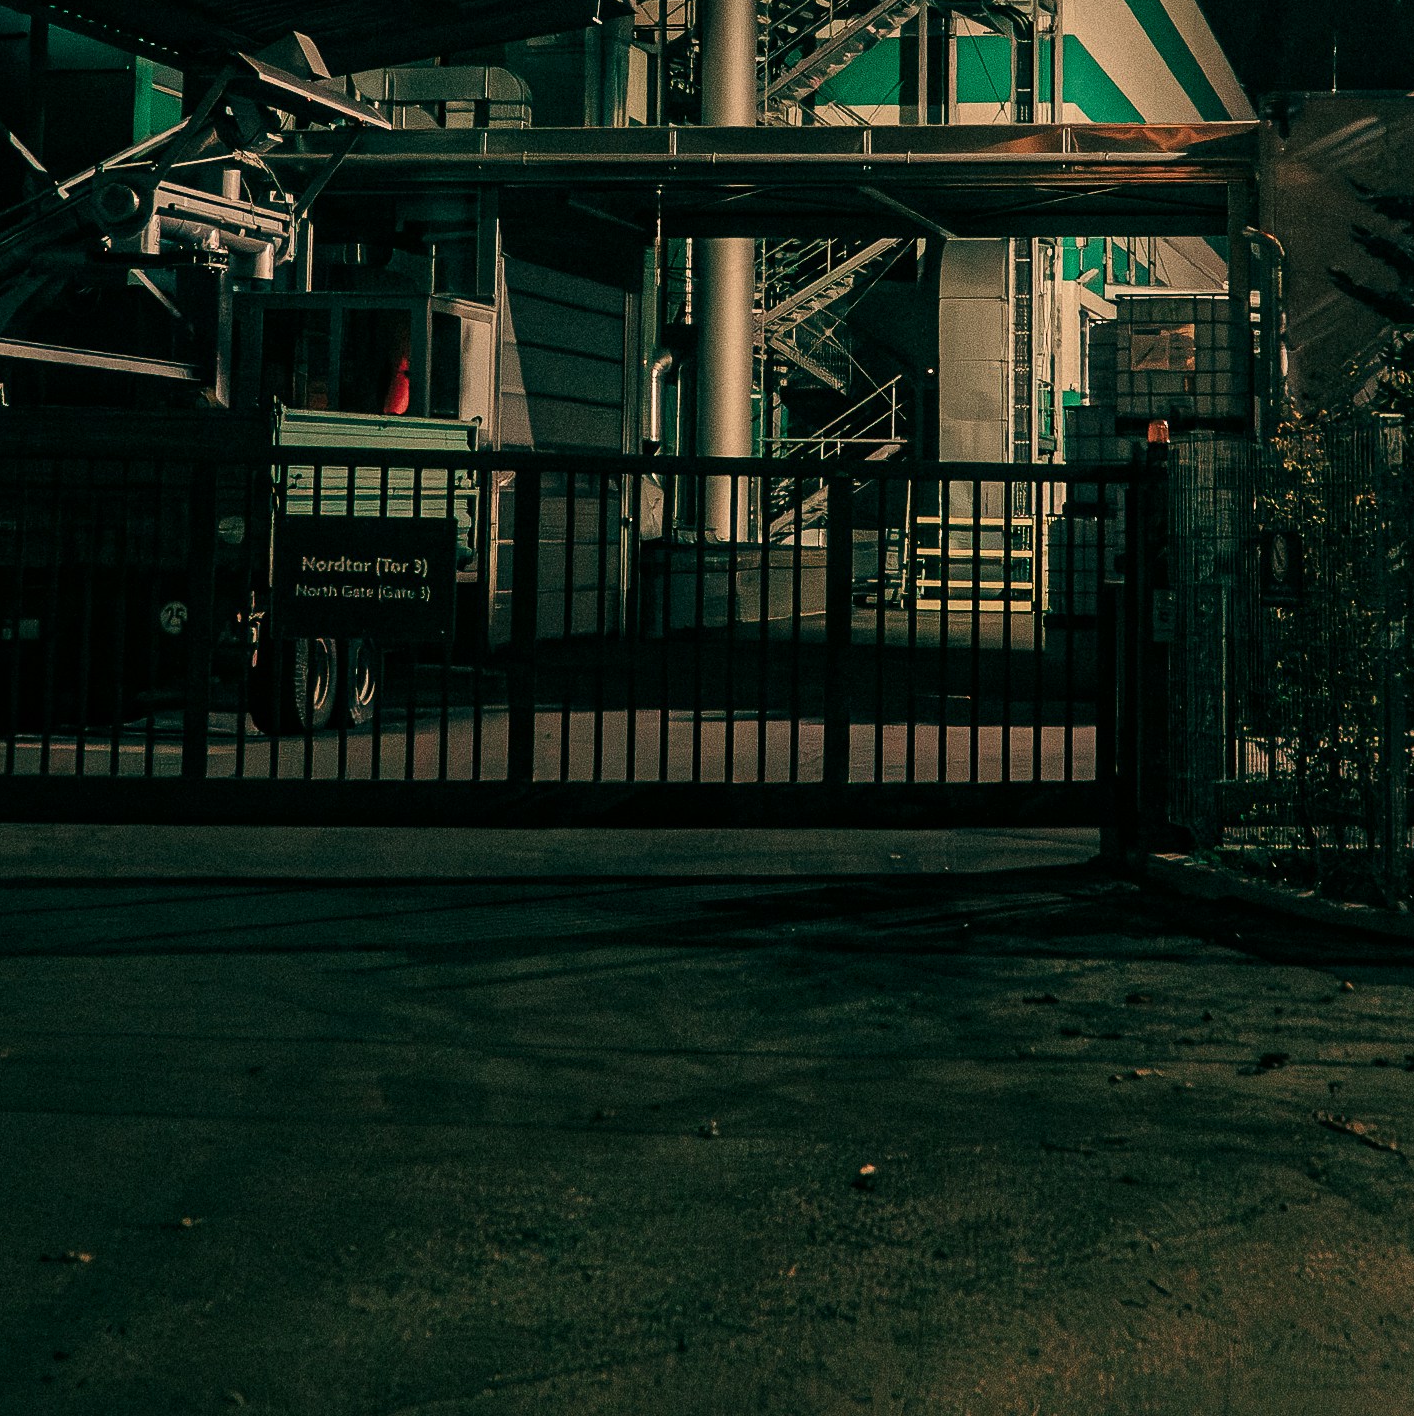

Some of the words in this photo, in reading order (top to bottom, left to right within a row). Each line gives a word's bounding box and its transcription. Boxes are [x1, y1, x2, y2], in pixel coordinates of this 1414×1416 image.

[301, 555, 372, 573] Nordtor
[375, 557, 409, 577] (Tor
[414, 557, 429, 578] 3)
[295, 583, 338, 597] North
[341, 585, 374, 598] Gate
[377, 585, 415, 602] (Gate
[420, 585, 431, 602] 3)
